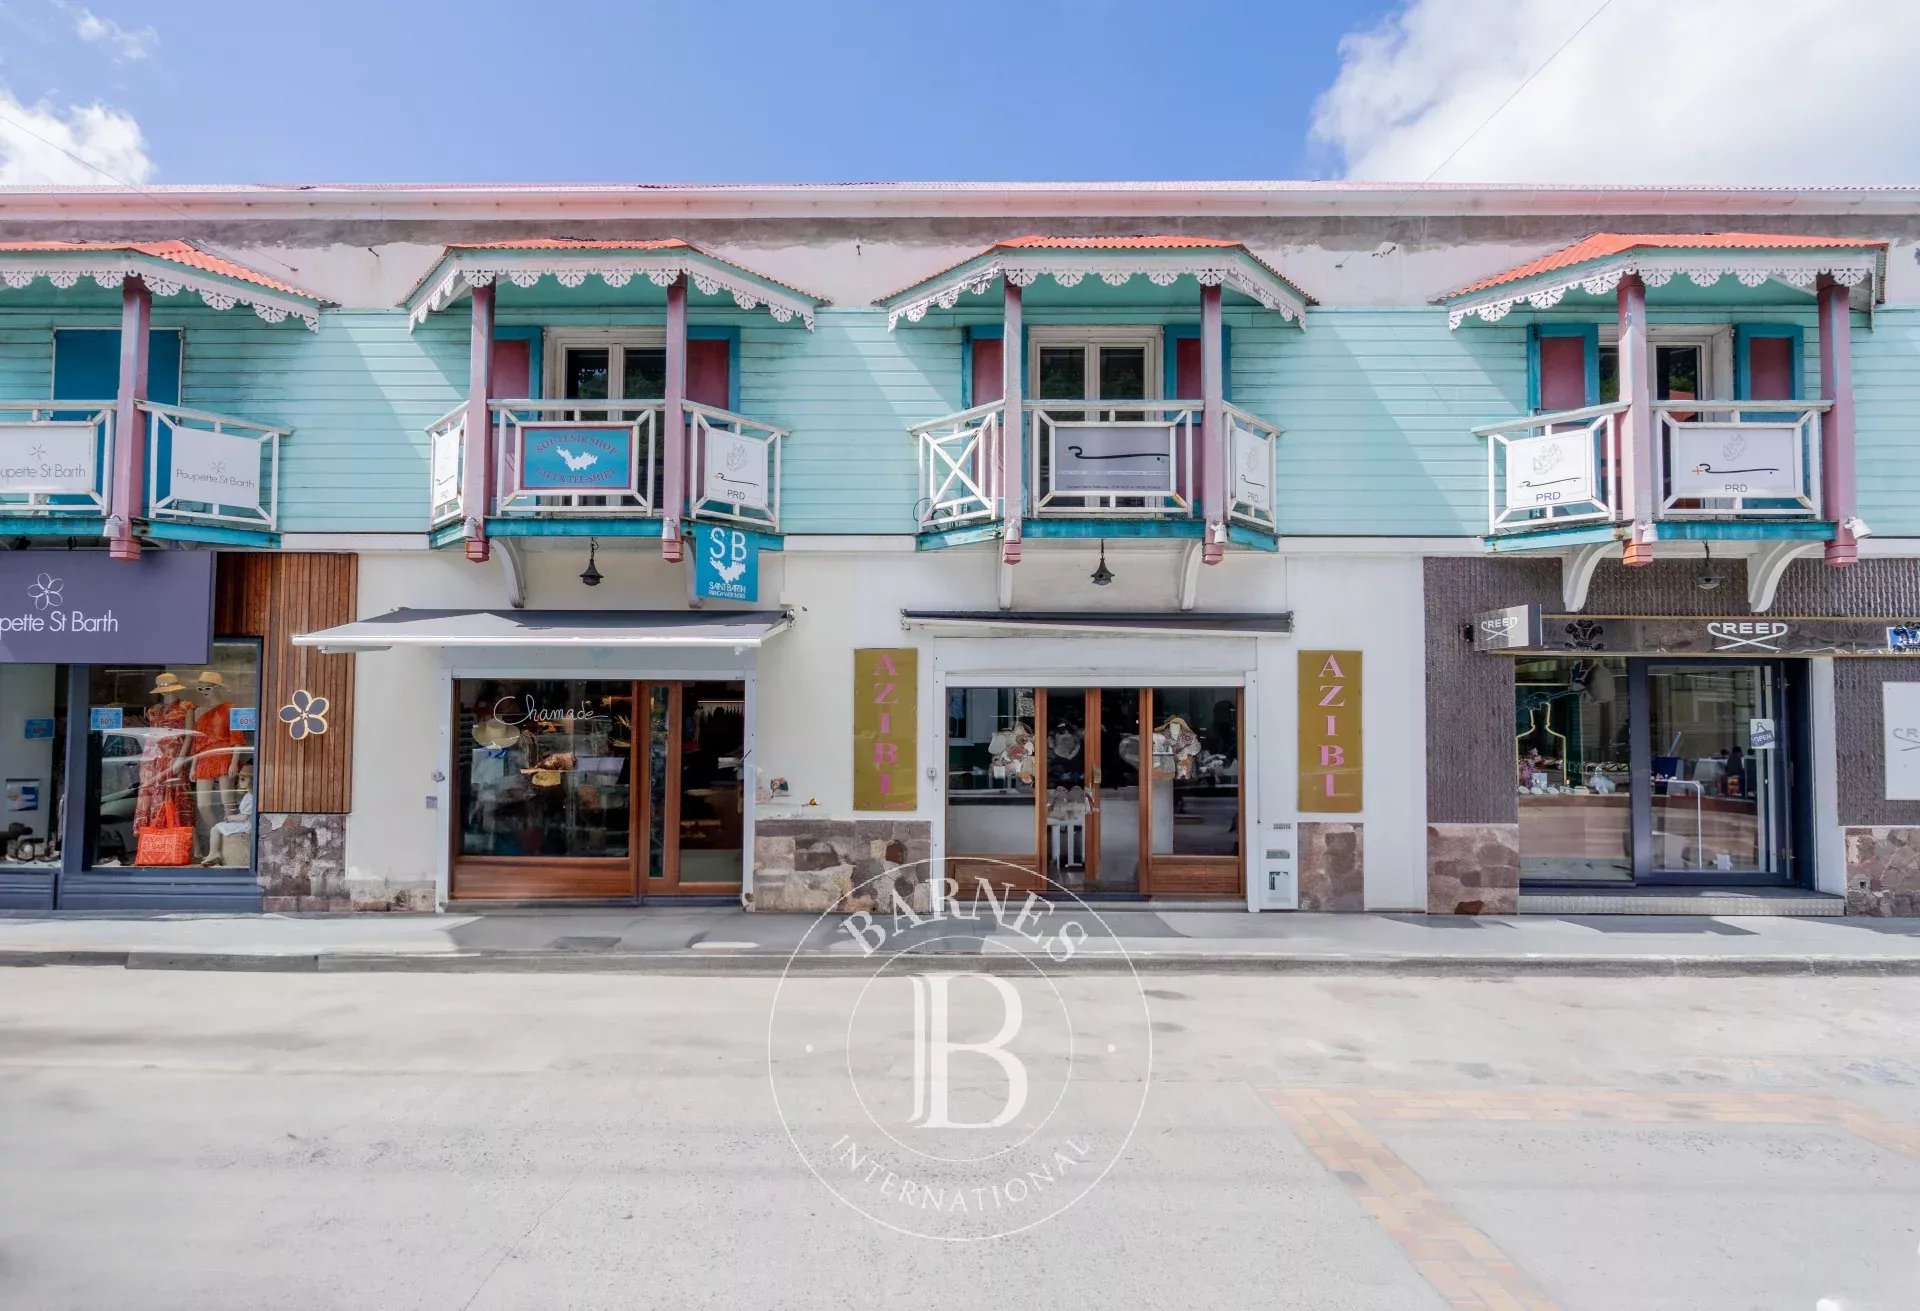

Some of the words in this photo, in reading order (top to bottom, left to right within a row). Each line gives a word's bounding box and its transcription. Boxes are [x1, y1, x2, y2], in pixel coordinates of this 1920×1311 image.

[536, 433, 589, 453] SOUVENIR
[590, 435, 617, 454] SHOP
[40, 463, 51, 478] St
[54, 463, 86, 478] Barth
[176, 468, 218, 484] Poupette
[219, 474, 228, 485] St
[229, 476, 255, 488] Barth
[727, 489, 745, 500] PRD
[1724, 484, 1748, 493] PRD
[1536, 491, 1561, 502] PRD
[49, 611, 67, 632] St
[71, 609, 118, 632] Barth
[872, 652, 899, 796] AZIBI
[1753, 734, 1771, 742] OPEN
